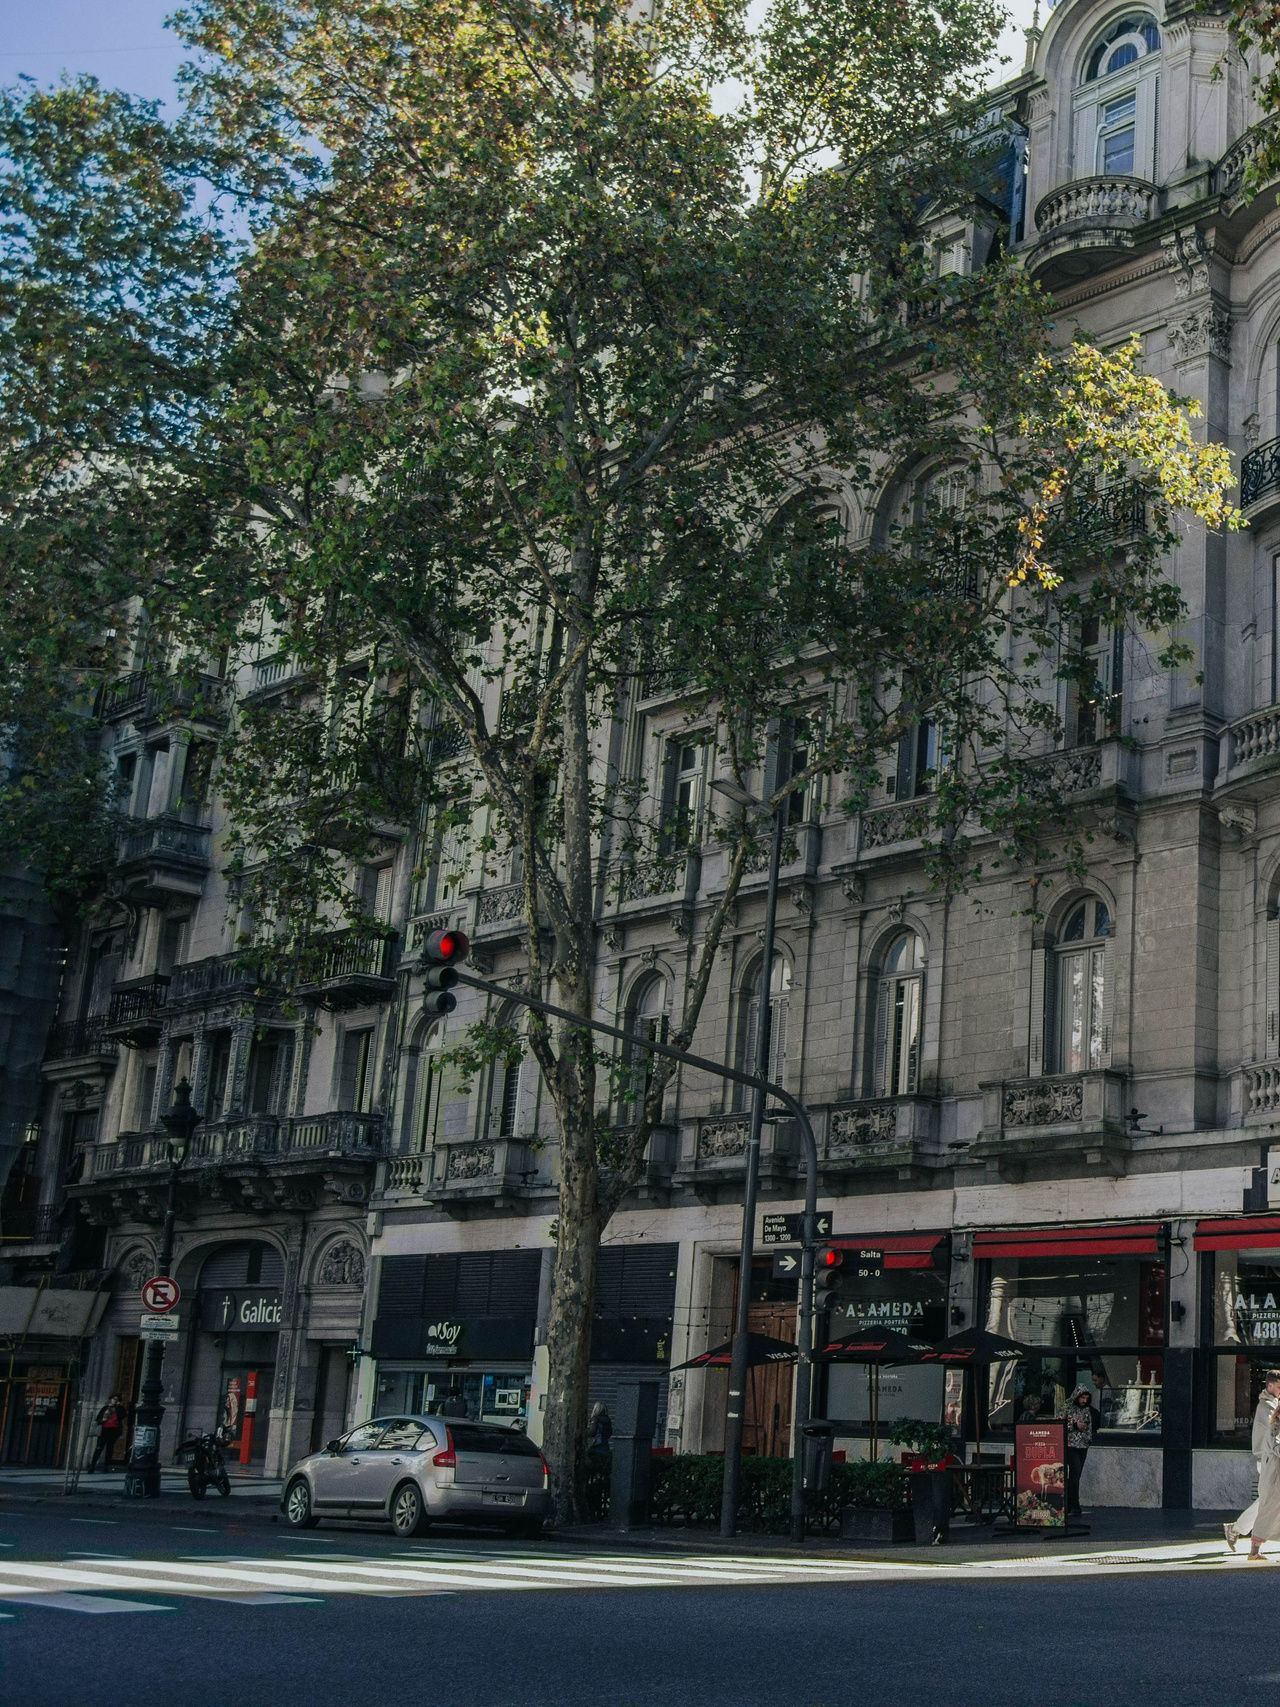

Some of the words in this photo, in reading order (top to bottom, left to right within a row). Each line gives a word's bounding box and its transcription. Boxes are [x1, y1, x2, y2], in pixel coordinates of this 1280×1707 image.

[765, 1216, 786, 1224] Avenida
[772, 1225, 786, 1233] Mayo
[240, 1298, 282, 1323] Galicia
[846, 1302, 924, 1317] ALAMEDA
[766, 1352, 791, 1360] VISA
[1026, 1447, 1056, 1459] DUPLA
